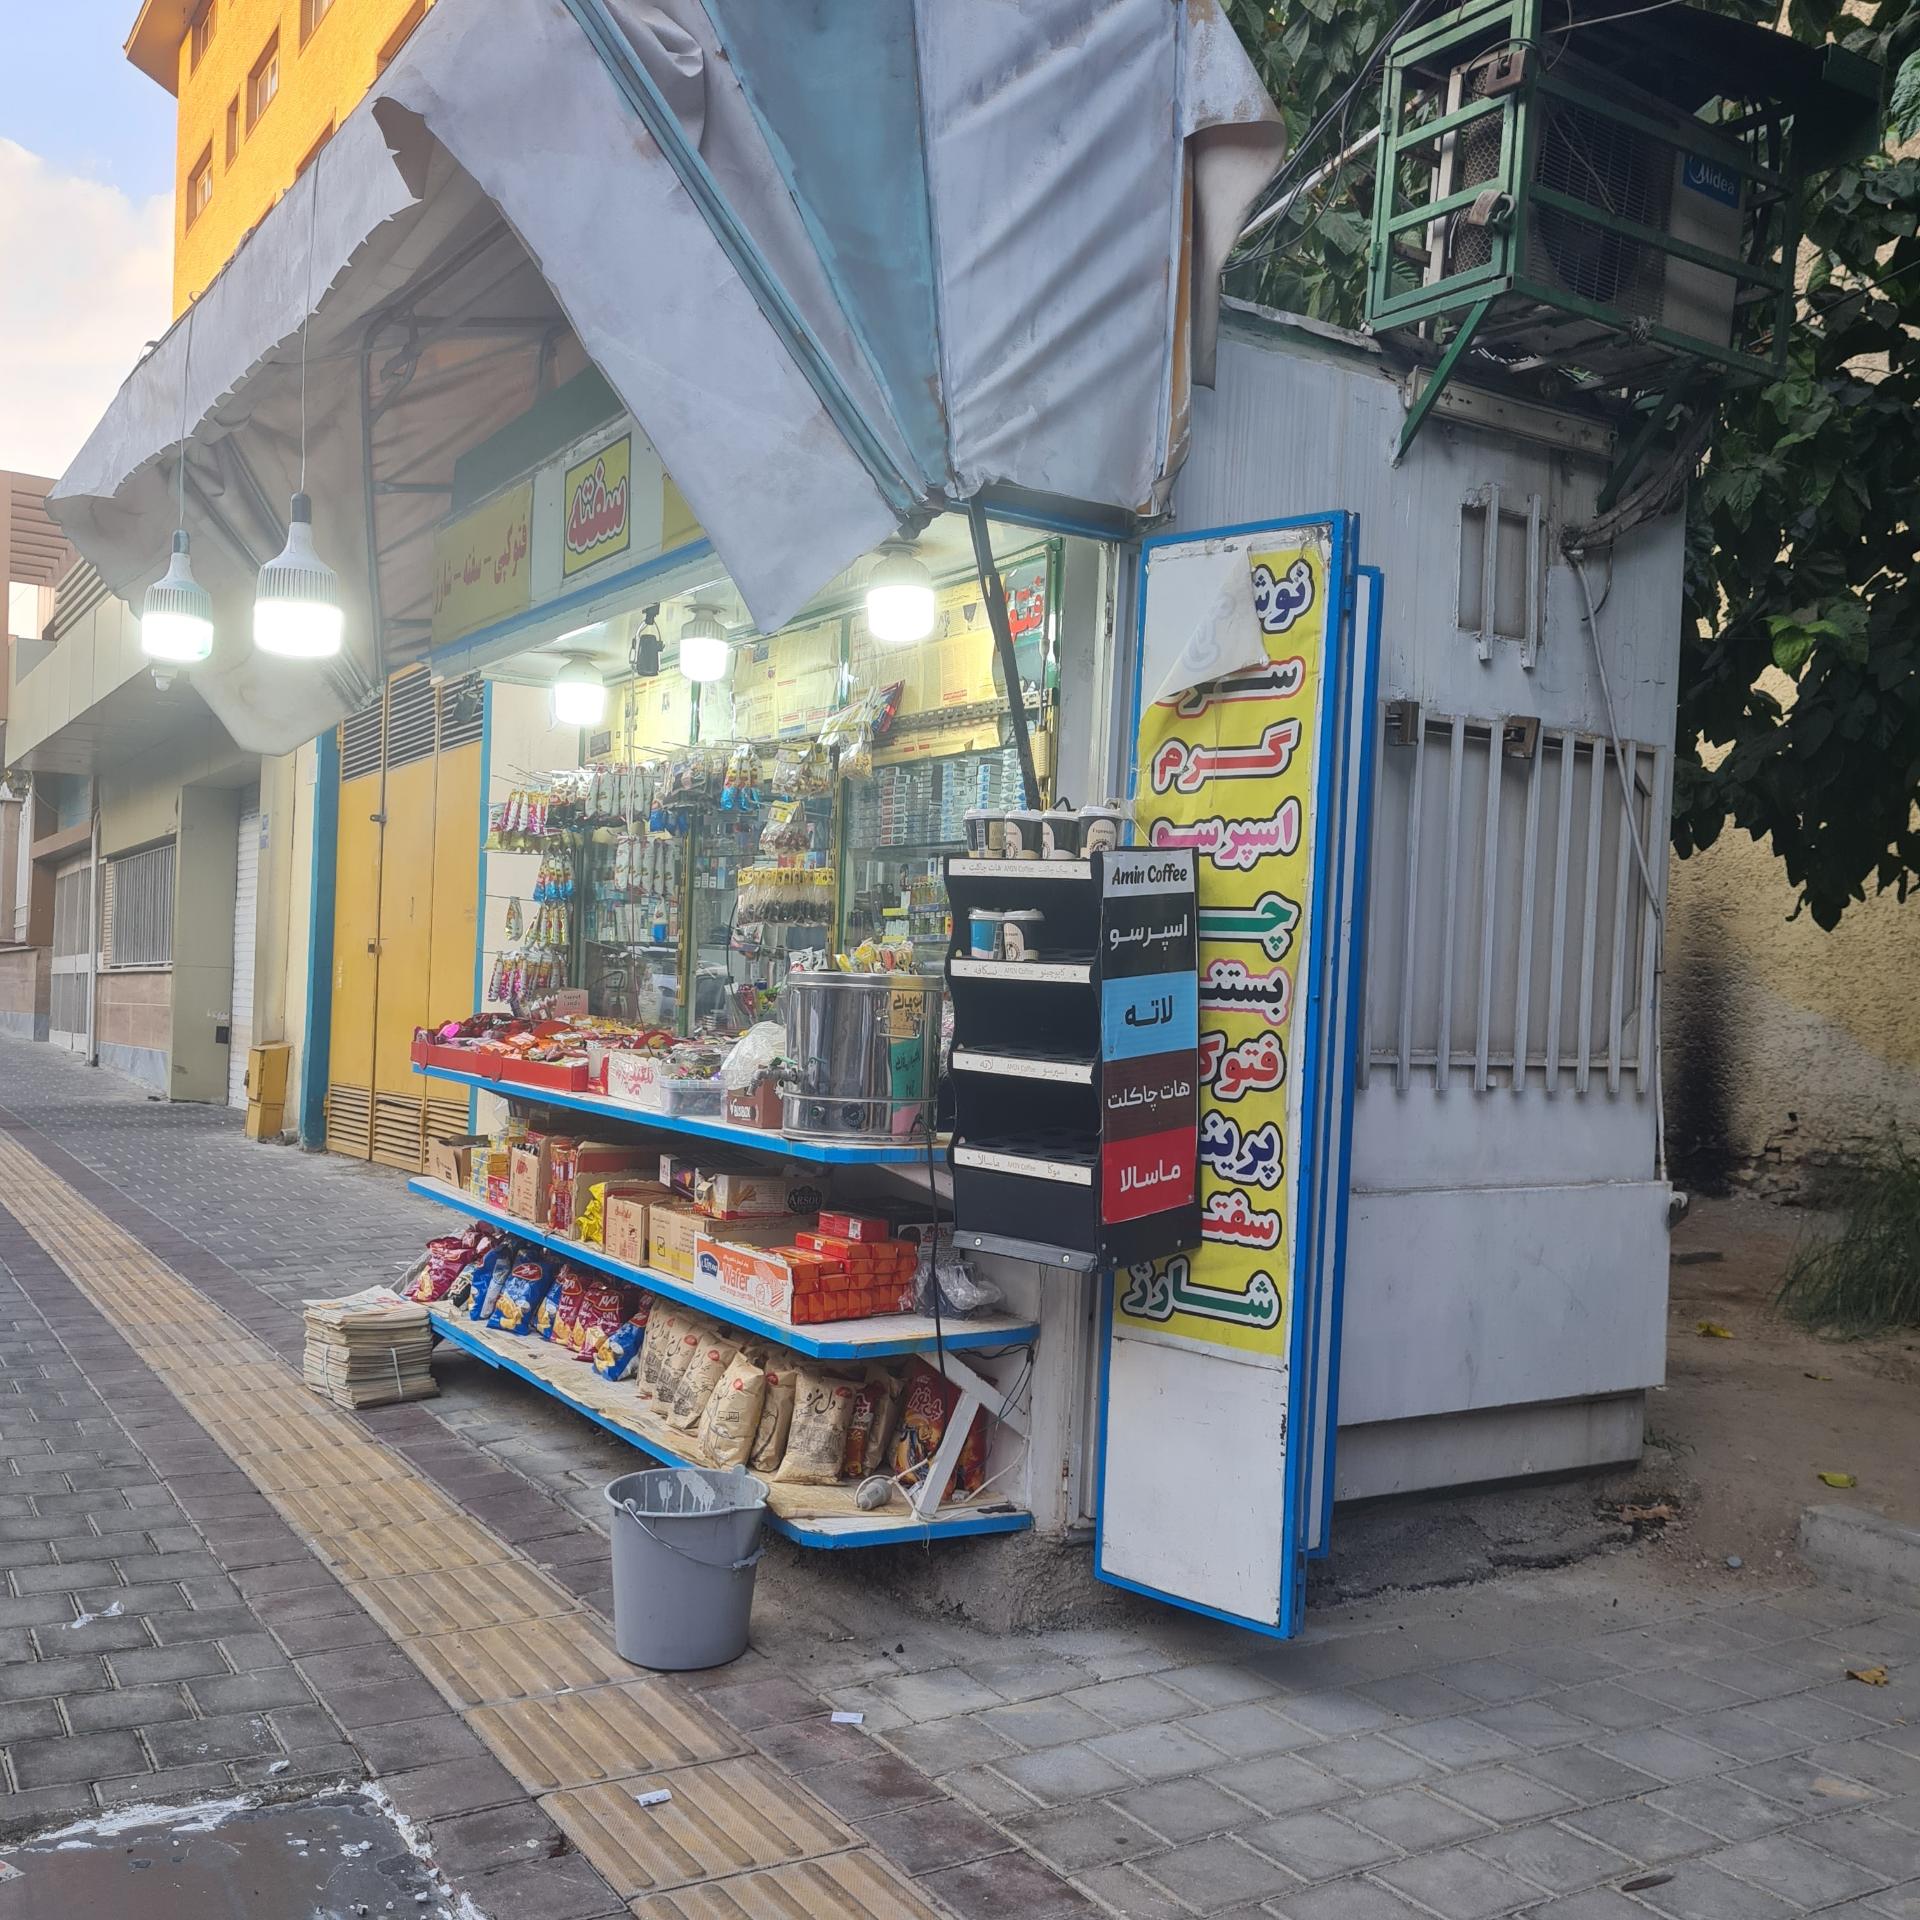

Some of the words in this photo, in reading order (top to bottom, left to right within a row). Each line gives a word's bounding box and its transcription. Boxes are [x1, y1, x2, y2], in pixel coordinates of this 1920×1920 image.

[1692, 163, 1735, 195] Midea
[566, 459, 627, 554] سفته
[1155, 723, 1296, 790] گرم
[1152, 800, 1297, 866] اسپرسو
[1112, 866, 1145, 885] Amin
[1148, 863, 1187, 883] Coffee
[1110, 914, 1187, 951] اسپرسو
[1200, 963, 1288, 1020] بستن
[1125, 995, 1173, 1027] لاته
[1200, 1034, 1284, 1095] فتوک
[1107, 1085, 1158, 1111] چاکلت
[1161, 1080, 1190, 1100] هات
[1200, 1113, 1279, 1184] پرین
[1119, 1164, 1181, 1192] ماسالا
[1201, 1194, 1277, 1246] سفت
[722, 1262, 750, 1291] Wafer
[1123, 1259, 1277, 1326] شارژ
[815, 1390, 836, 1414] دل
